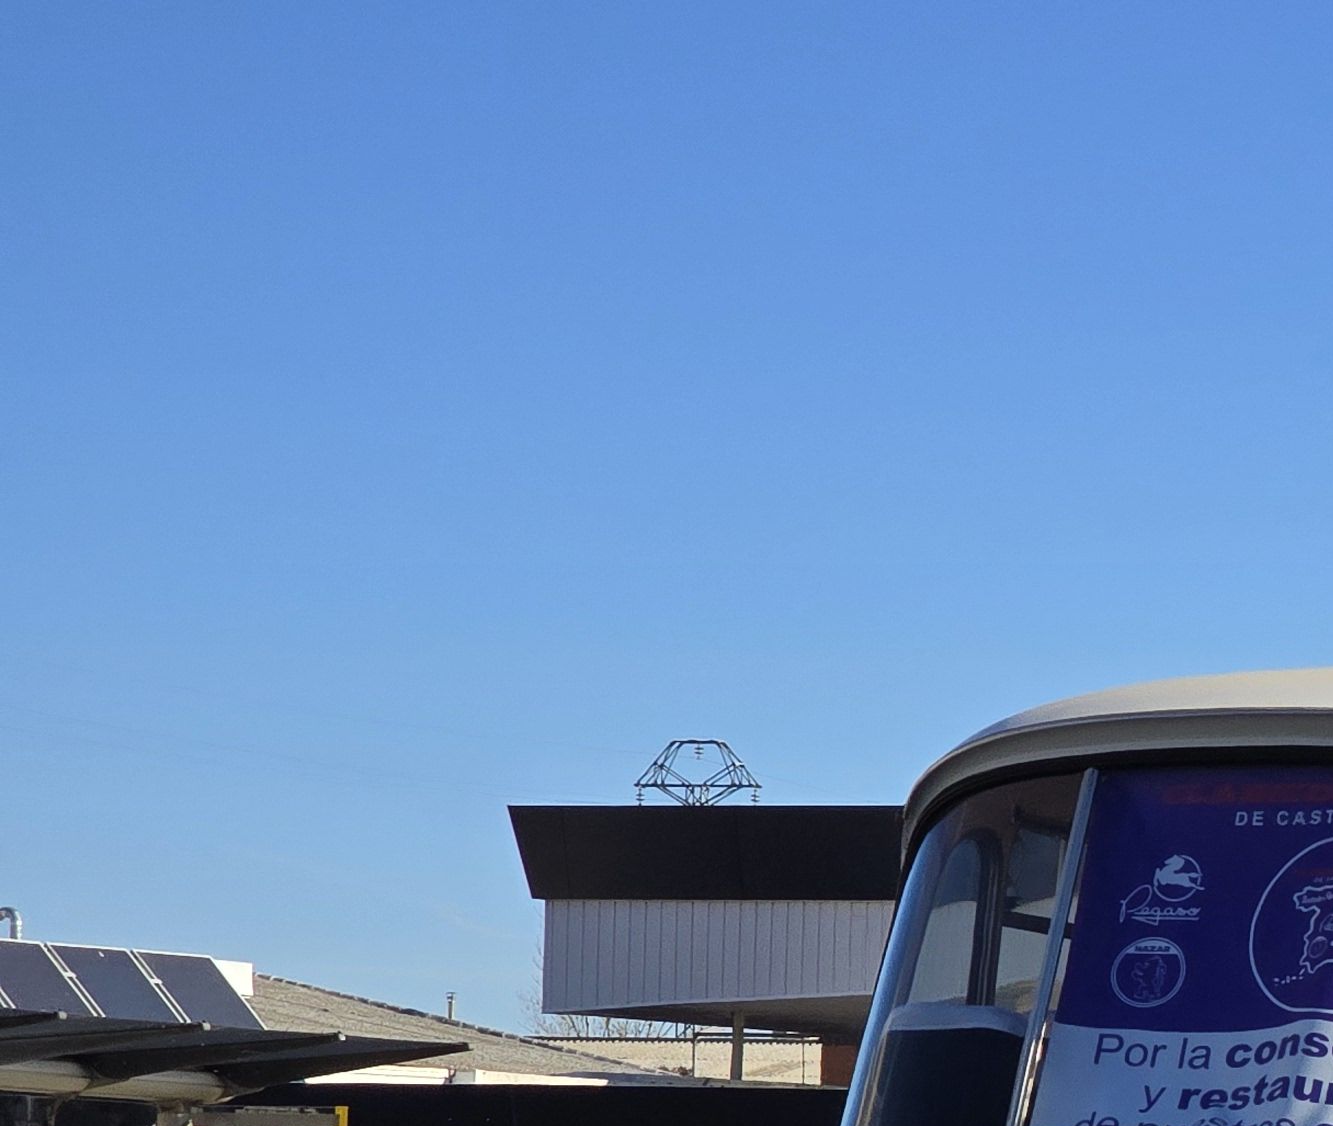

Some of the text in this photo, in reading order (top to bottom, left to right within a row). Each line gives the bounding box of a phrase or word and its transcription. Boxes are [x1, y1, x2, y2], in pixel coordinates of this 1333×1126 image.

[1235, 811, 1265, 827] DE
[1094, 1033, 1168, 1068] Por
[1178, 1038, 1211, 1070] la
[1138, 1084, 1166, 1113] y
